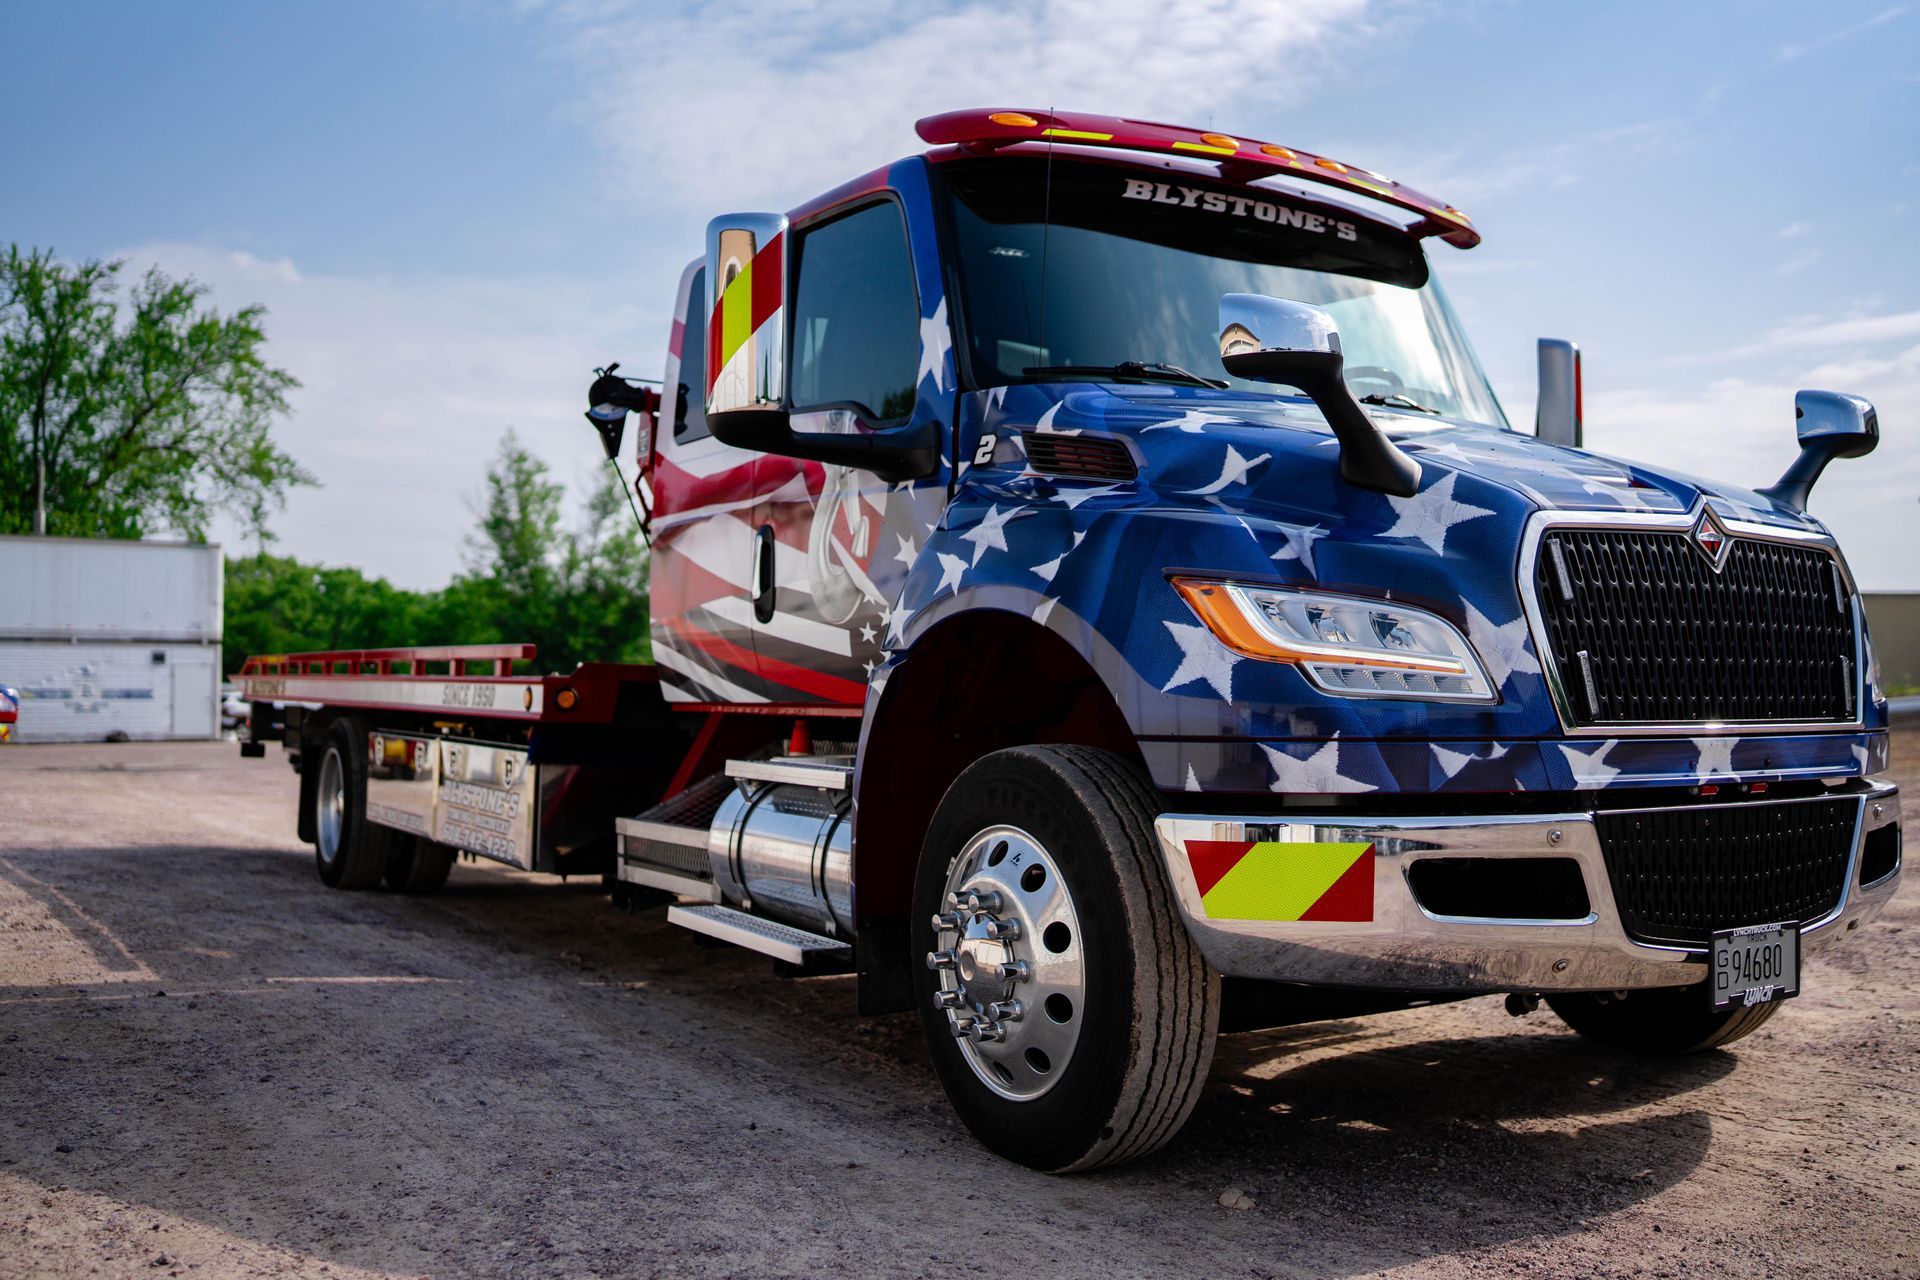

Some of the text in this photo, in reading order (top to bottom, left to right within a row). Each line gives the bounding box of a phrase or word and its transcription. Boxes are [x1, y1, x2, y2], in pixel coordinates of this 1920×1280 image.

[1121, 178, 1358, 242] BLYSTONE'S
[973, 433, 997, 465] 2
[442, 683, 470, 705] SINCE
[441, 779, 520, 818] BLYSTONE'S
[1732, 943, 1782, 984] 94680
[1743, 985, 1775, 1007] LYNCH
